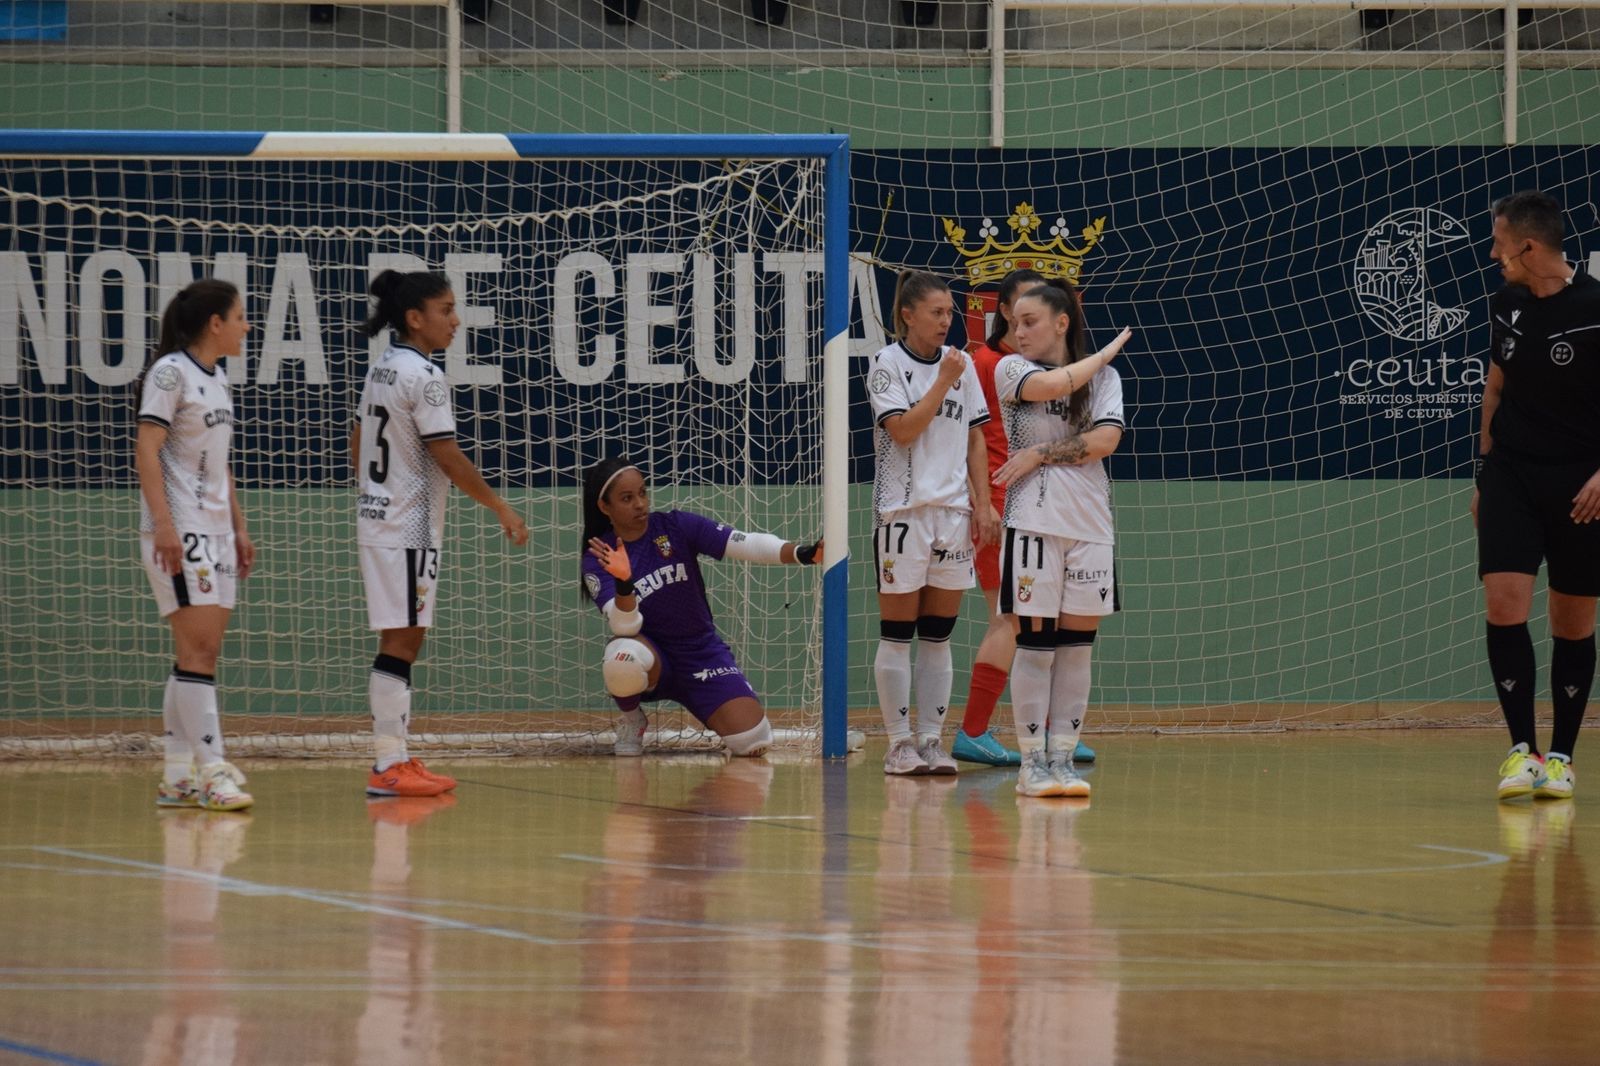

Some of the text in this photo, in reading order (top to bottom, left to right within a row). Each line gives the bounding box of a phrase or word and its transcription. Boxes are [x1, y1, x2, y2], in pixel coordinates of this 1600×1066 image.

[1339, 390, 1482, 405] SERVICIOS TURÍSTIC
[1384, 408, 1454, 419] DE CEUTA
[884, 522, 910, 554] 17
[1019, 535, 1044, 570] 11
[416, 548, 438, 580] 13
[1067, 569, 1108, 580] HELITY
[632, 562, 689, 603] EUTA
